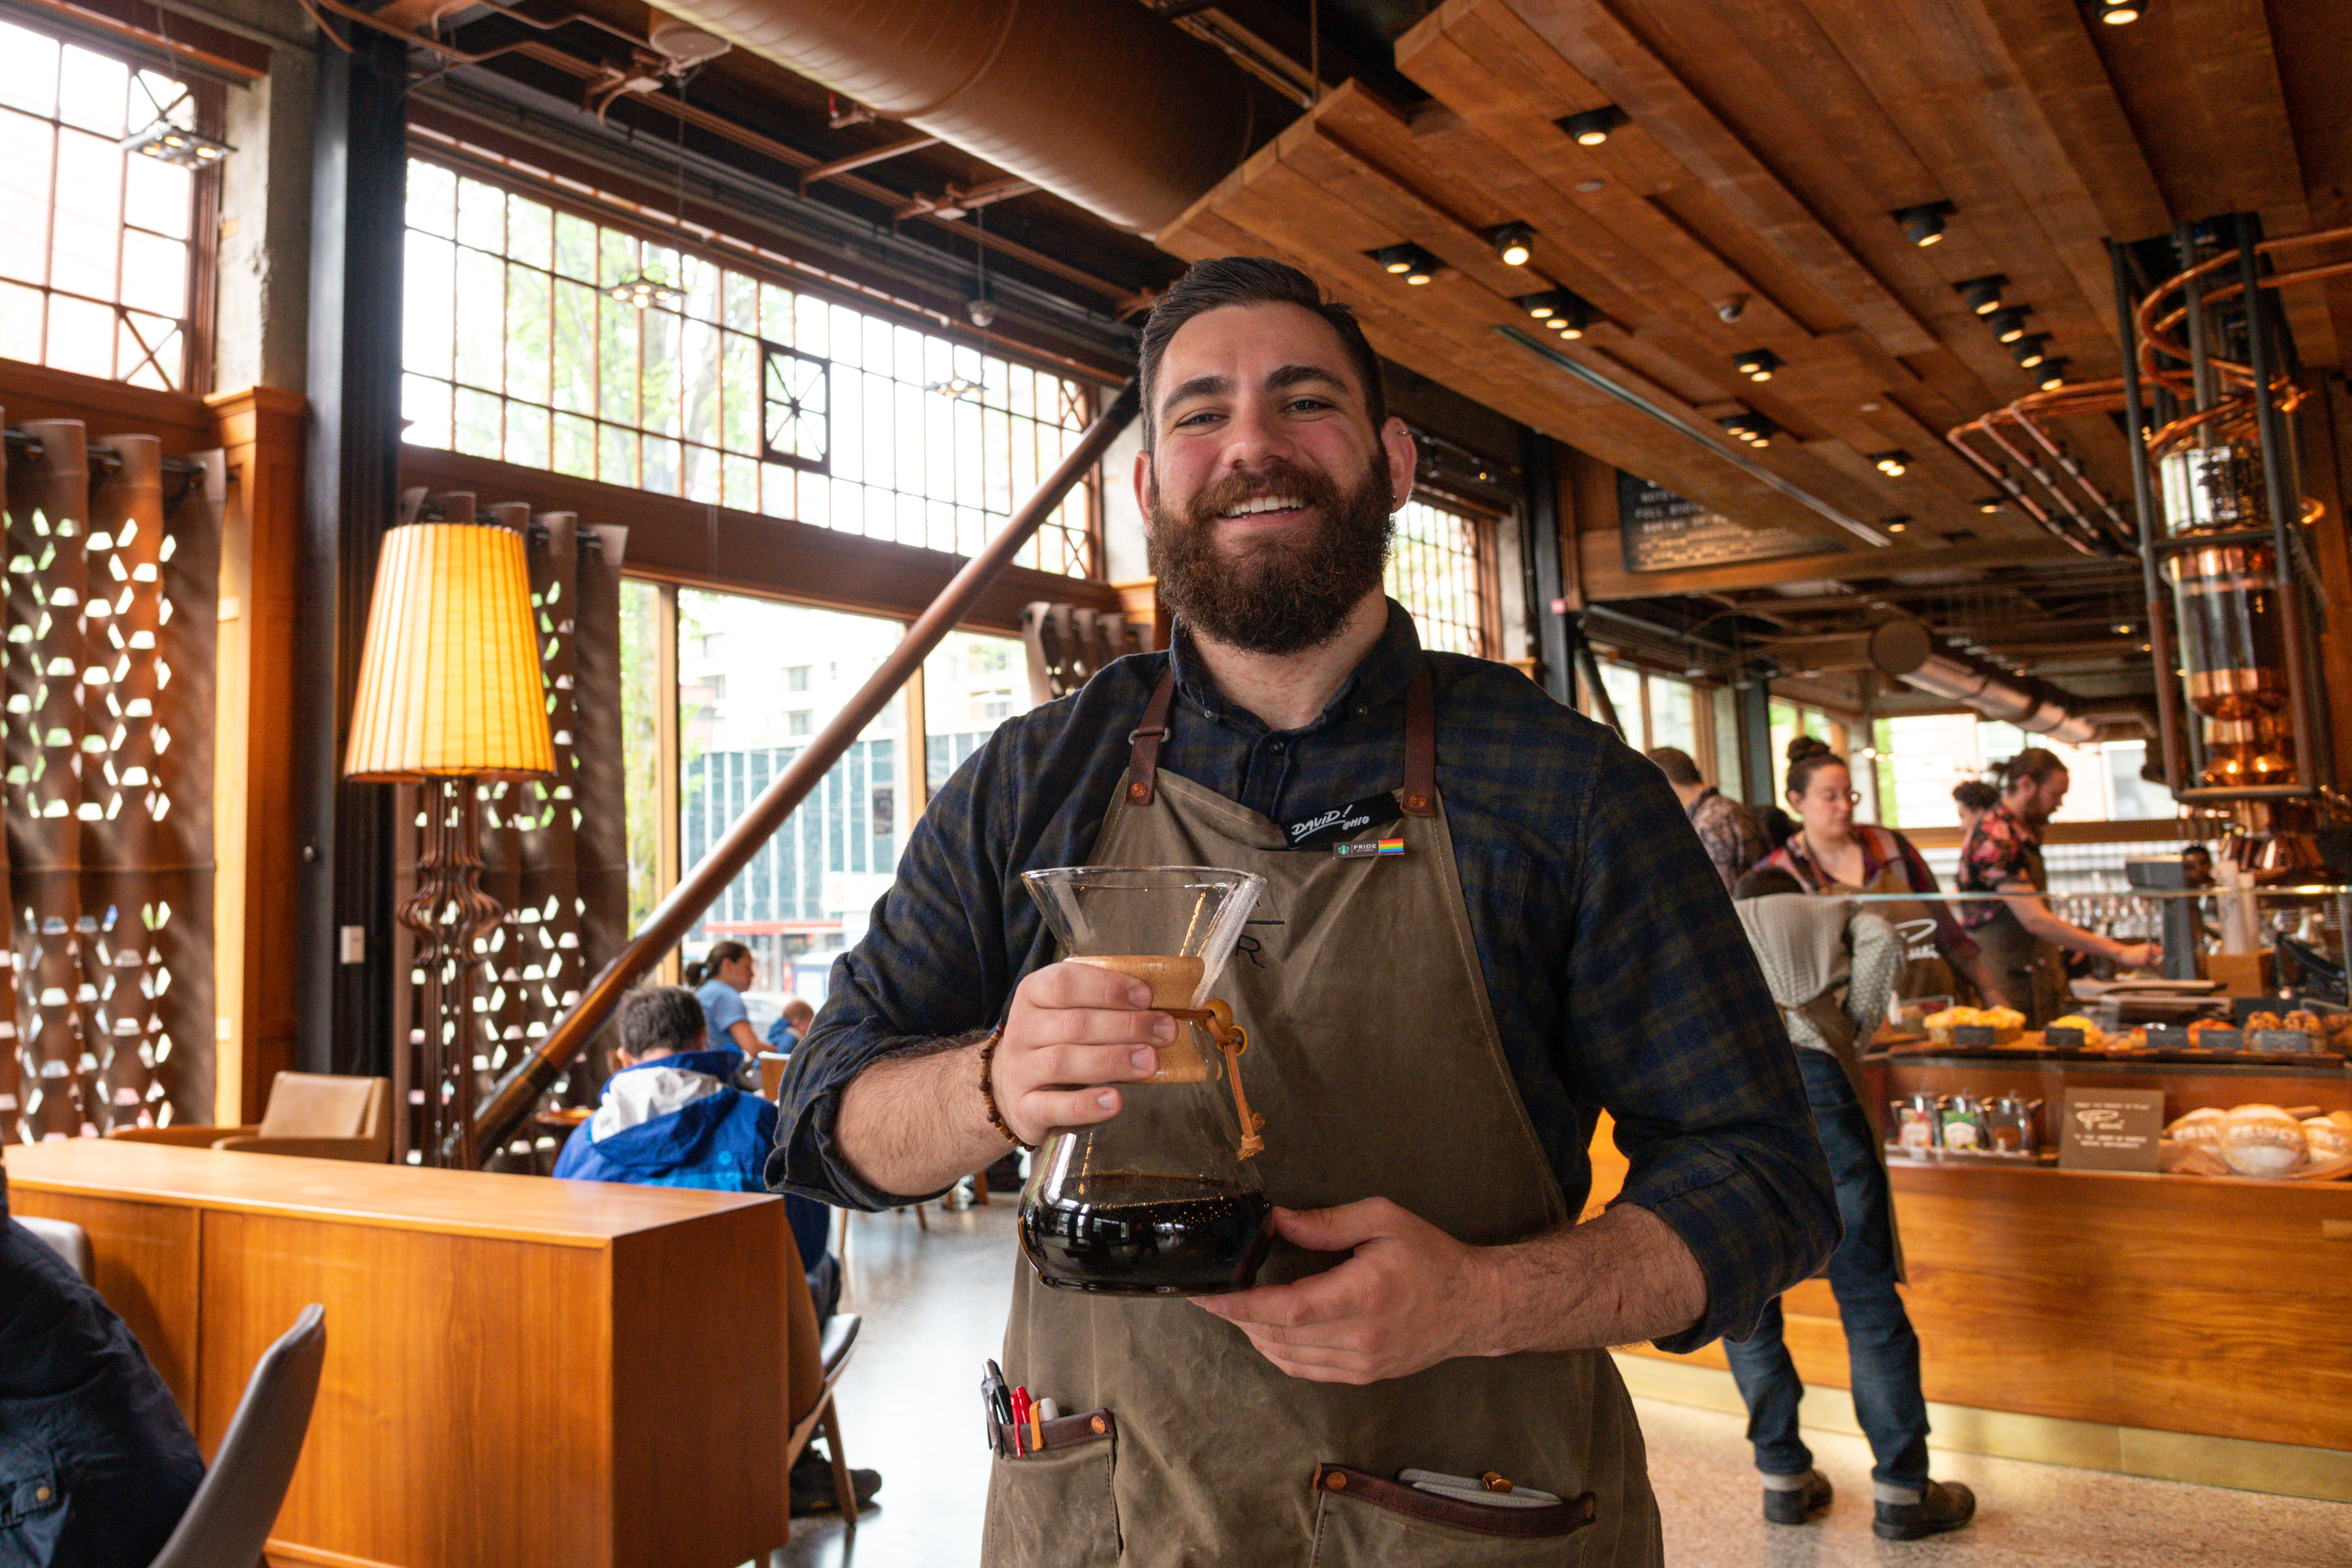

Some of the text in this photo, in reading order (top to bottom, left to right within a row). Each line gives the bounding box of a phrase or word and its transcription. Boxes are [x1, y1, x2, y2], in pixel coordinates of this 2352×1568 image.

[1291, 804, 1353, 836] DAVID!
[1342, 815, 1370, 830] OHIO
[1235, 934, 1266, 968] R
